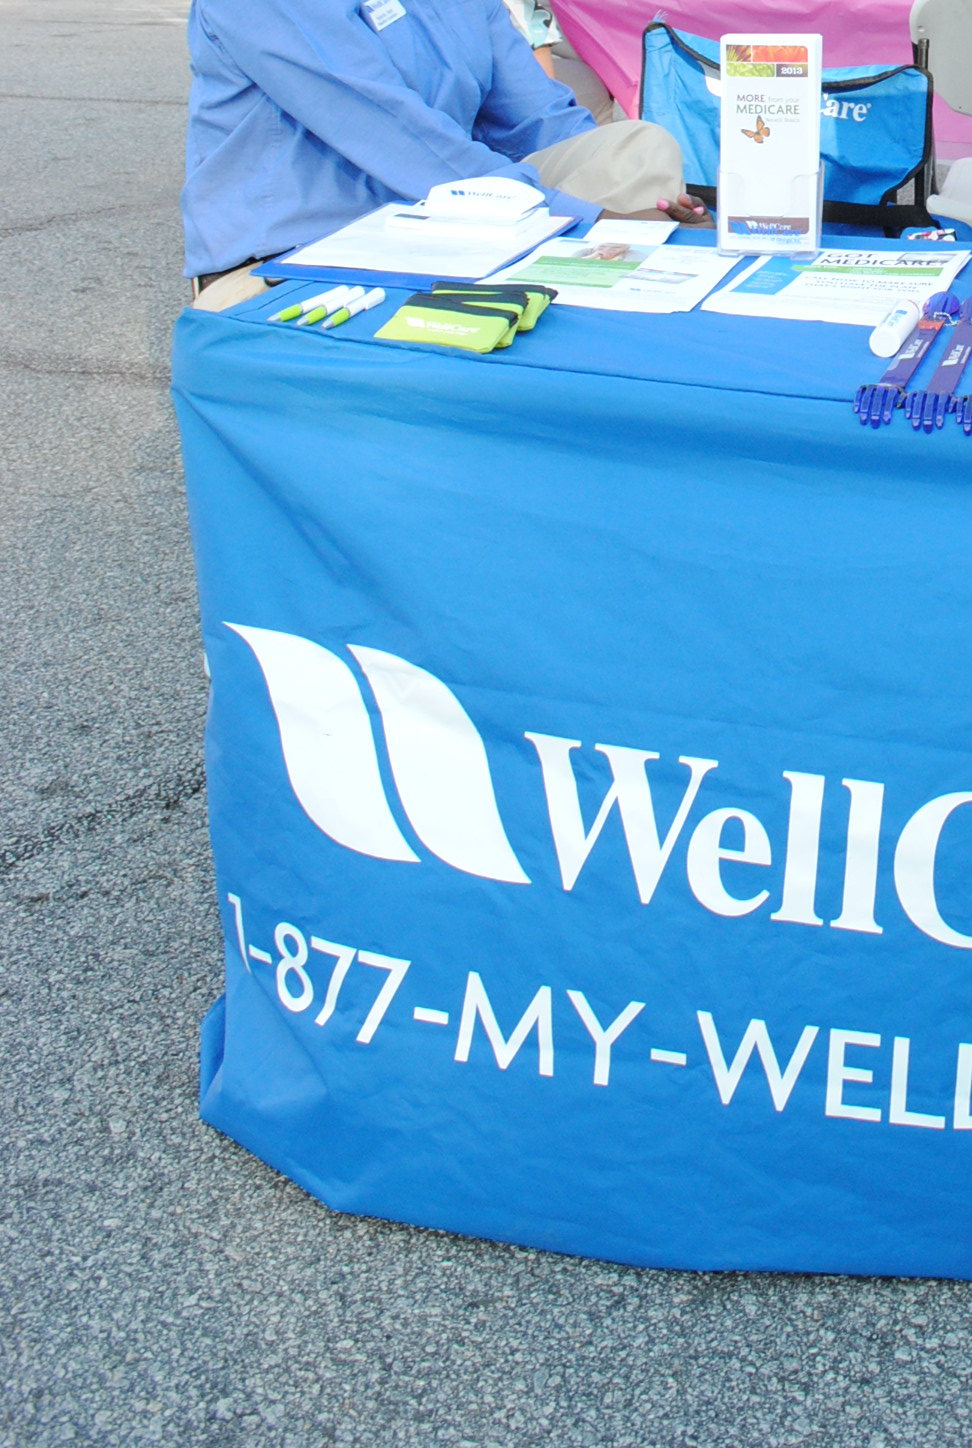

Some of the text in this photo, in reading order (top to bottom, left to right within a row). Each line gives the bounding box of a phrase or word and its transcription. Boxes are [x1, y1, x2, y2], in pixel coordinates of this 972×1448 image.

[780, 66, 803, 75] 2013
[736, 94, 800, 105] MORE from your
[736, 104, 800, 115] MEDICARE
[820, 259, 951, 268] MEDICARE?
